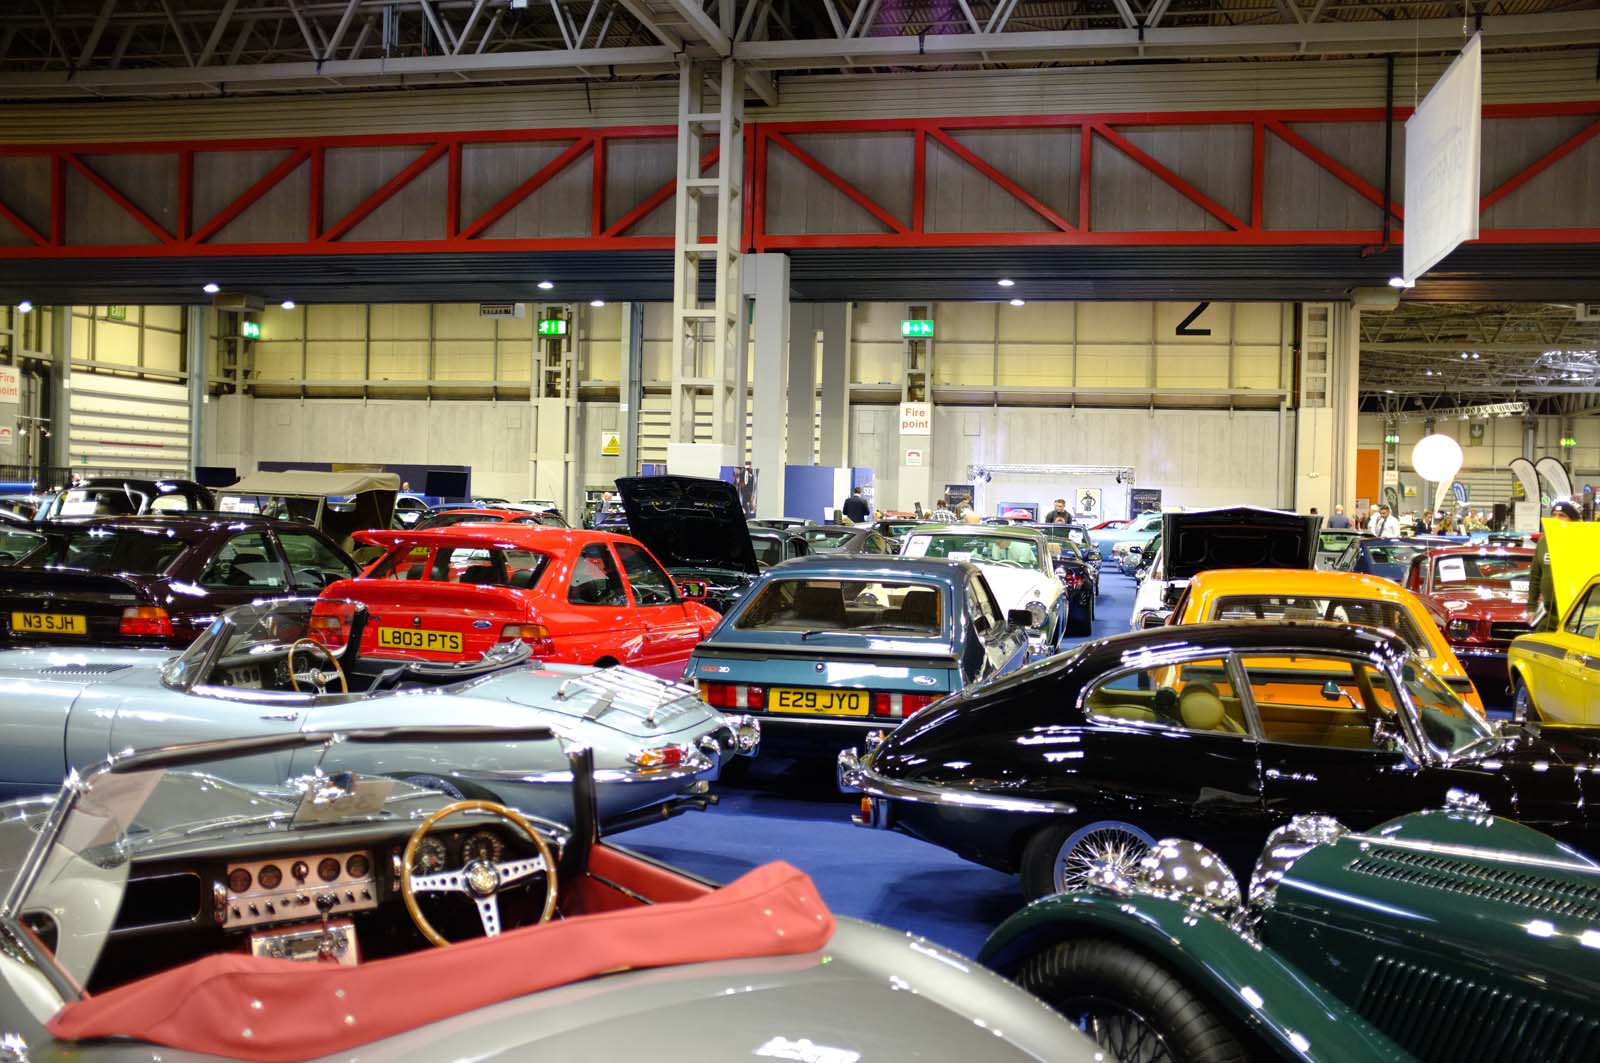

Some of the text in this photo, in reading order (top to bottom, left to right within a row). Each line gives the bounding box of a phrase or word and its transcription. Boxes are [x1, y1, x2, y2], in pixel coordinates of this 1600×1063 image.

[0, 387, 17, 396] oint
[905, 408, 926, 417] Fire
[902, 420, 929, 430] point
[23, 614, 74, 631] N3 SJH
[381, 629, 459, 650] L803 PTS
[779, 691, 860, 710] E29 JYO
